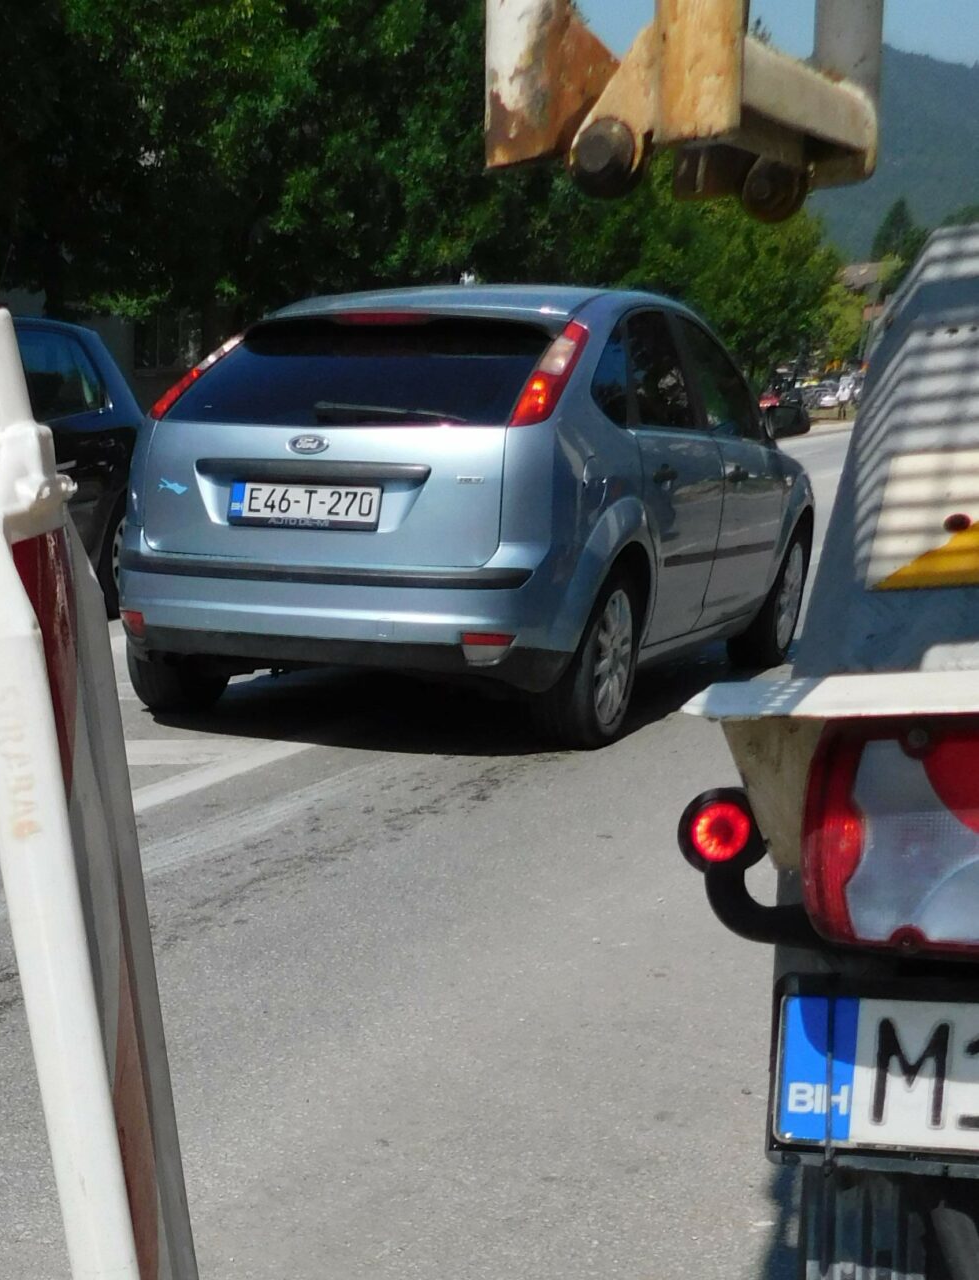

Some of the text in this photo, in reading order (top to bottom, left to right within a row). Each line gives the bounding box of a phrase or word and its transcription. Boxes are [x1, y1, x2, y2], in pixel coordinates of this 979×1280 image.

[248, 487, 374, 517] E46-T-270
[268, 517, 297, 526] AUTO
[787, 1082, 850, 1116] BIH
